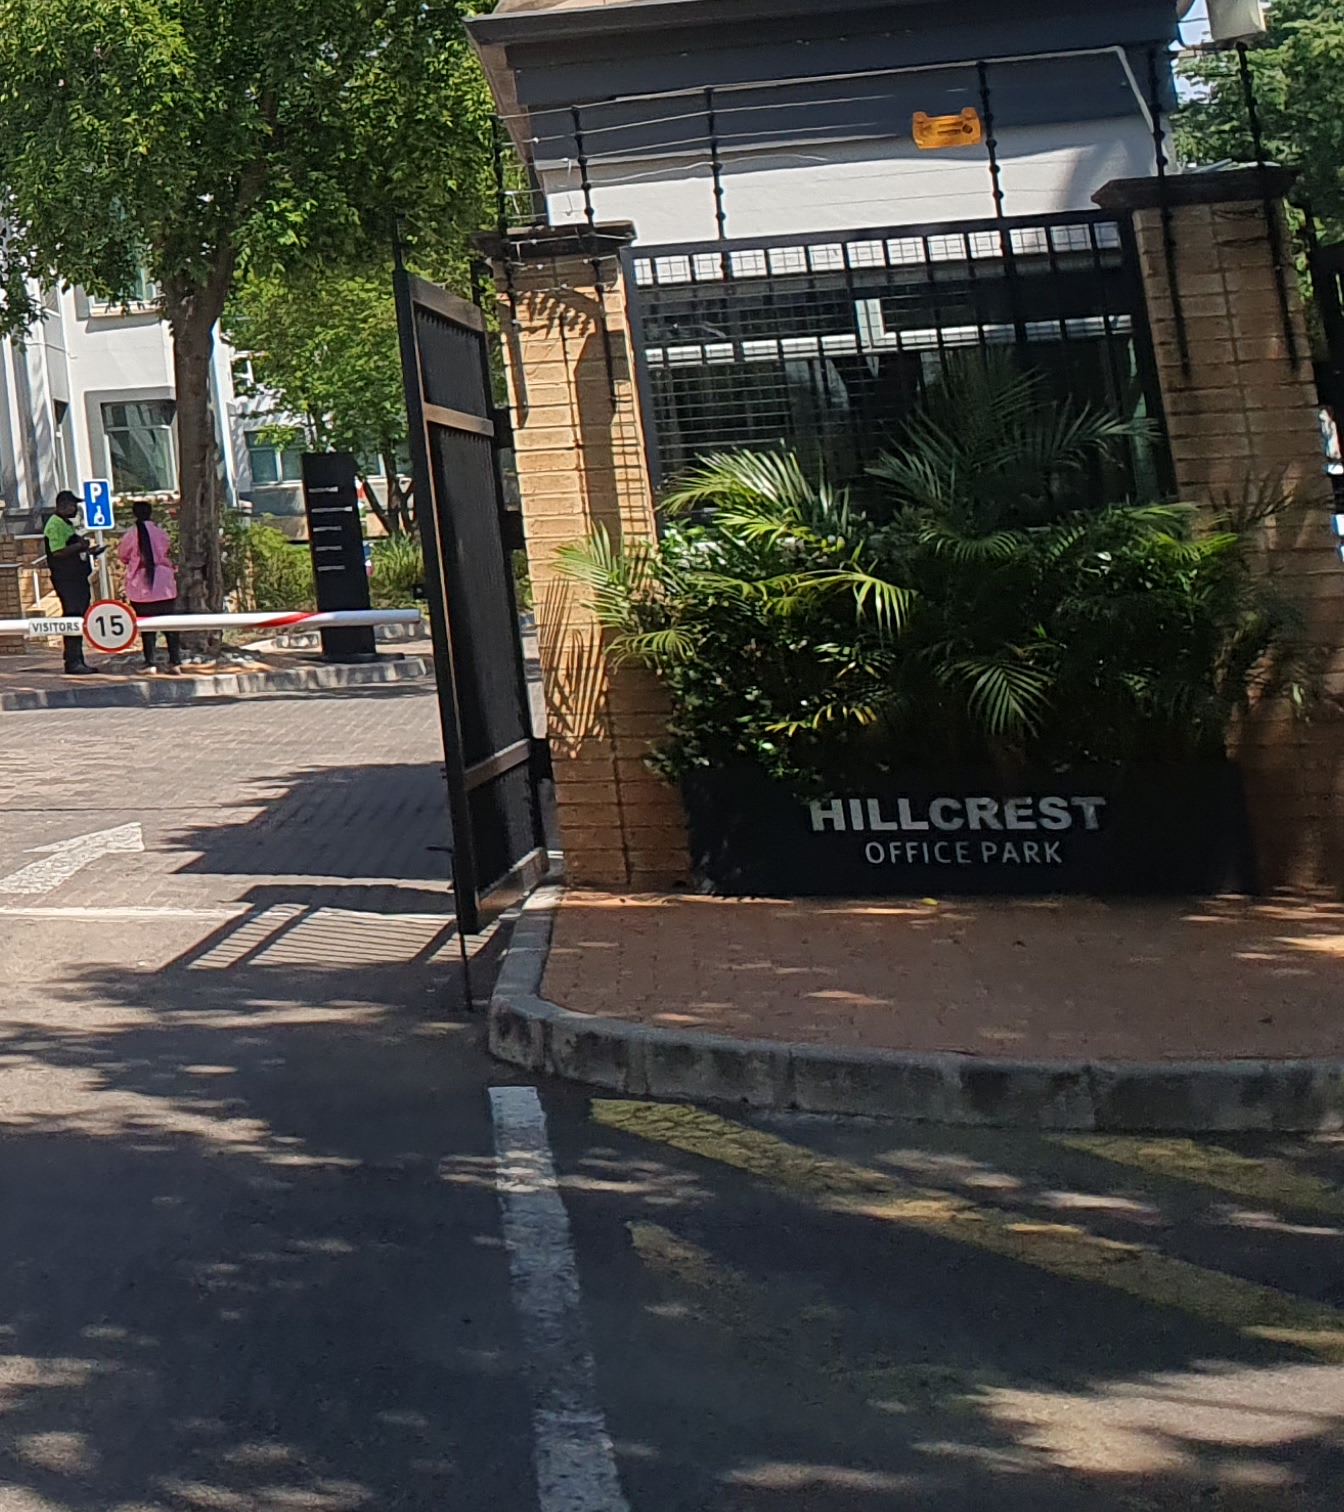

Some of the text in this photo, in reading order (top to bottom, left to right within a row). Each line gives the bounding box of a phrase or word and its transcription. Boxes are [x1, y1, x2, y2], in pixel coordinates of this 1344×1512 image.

[89, 482, 102, 503] P
[32, 621, 81, 633] VISITORS
[95, 615, 125, 637] 15
[810, 795, 1107, 832] HILLCREST
[864, 839, 1064, 865] OFFICE PARK
